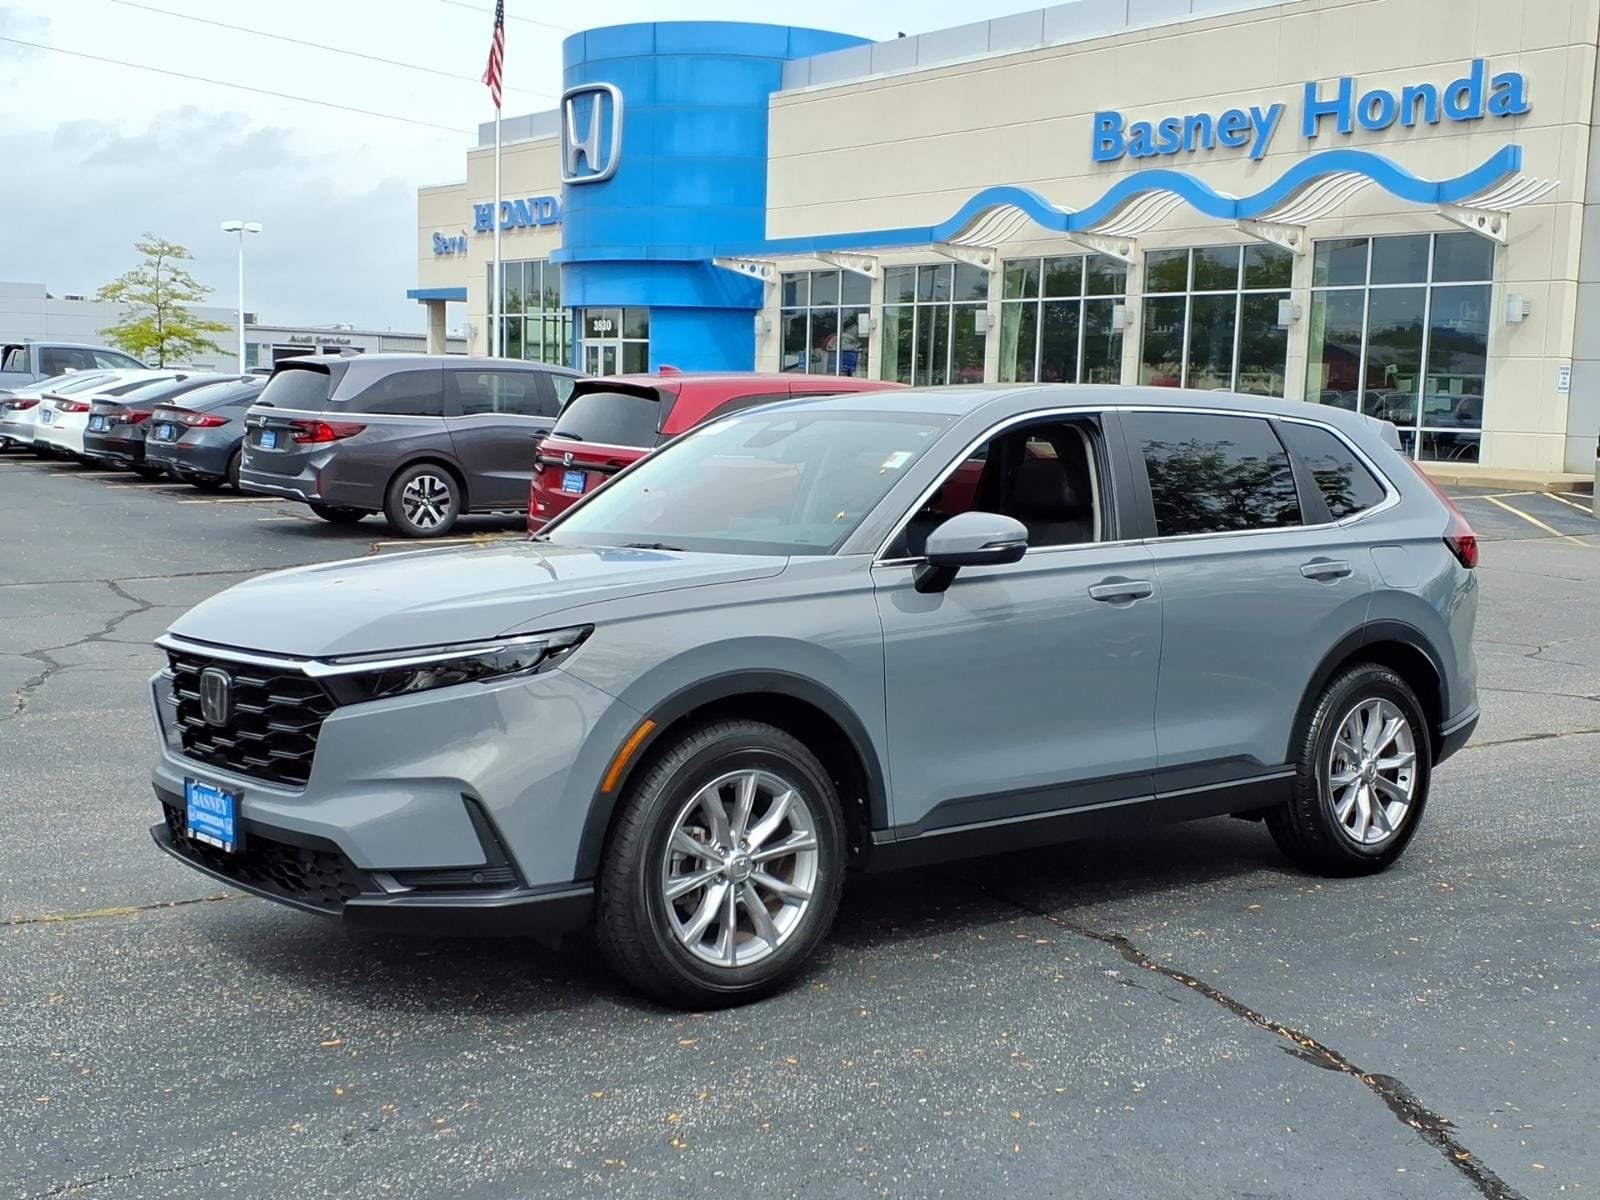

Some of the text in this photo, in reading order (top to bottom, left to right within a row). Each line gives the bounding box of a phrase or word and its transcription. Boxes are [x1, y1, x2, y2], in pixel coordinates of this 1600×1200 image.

[1092, 59, 1531, 163] Basney Honda
[473, 196, 562, 233] HOND
[290, 335, 351, 345] Audi Service
[192, 790, 228, 816] BASNEY
